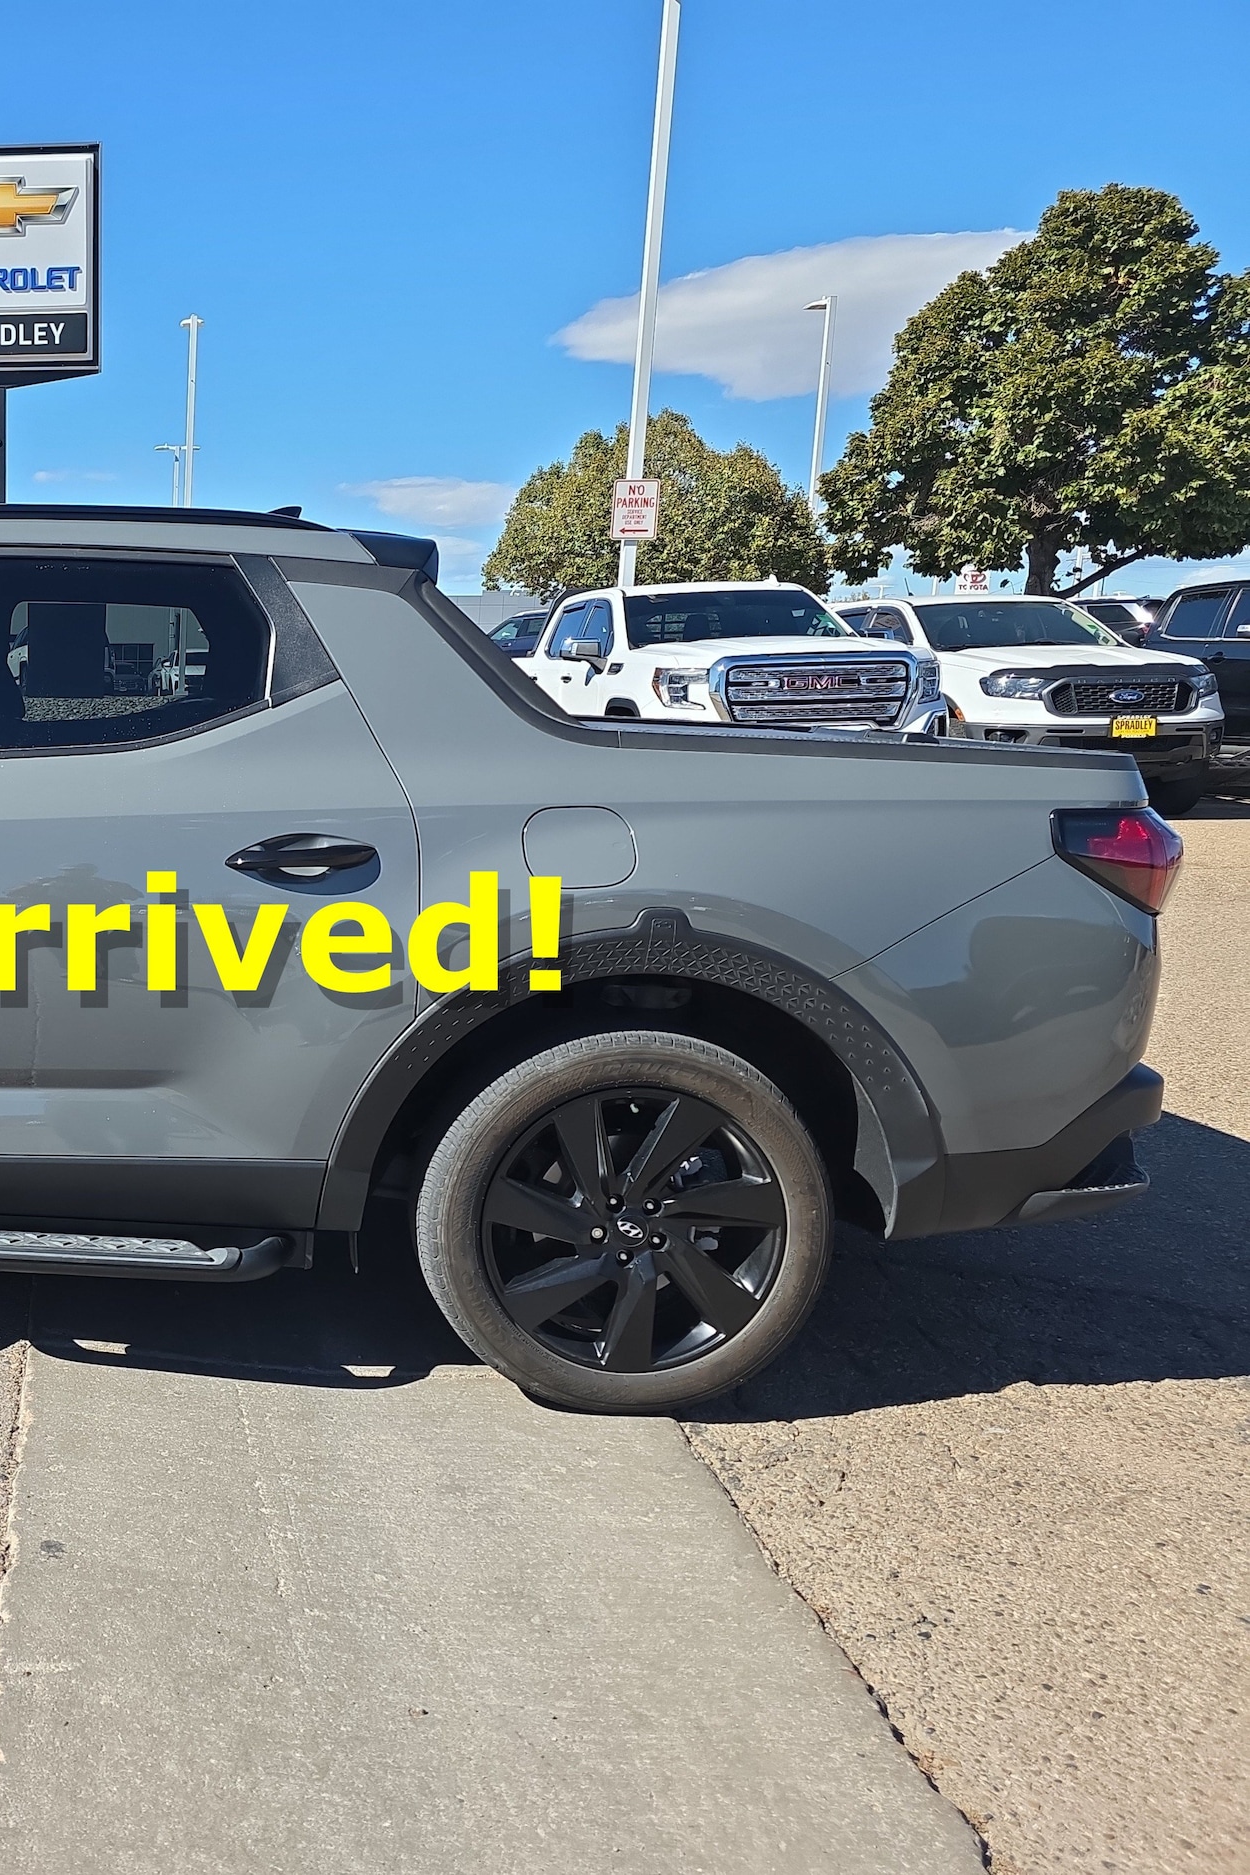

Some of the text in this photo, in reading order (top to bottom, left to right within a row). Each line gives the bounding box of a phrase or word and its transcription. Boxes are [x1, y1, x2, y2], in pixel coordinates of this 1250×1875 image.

[628, 484, 645, 496] NO
[616, 497, 655, 508] PARKING
[783, 675, 858, 690] GMC
[1115, 720, 1153, 730] SPRADLEY
